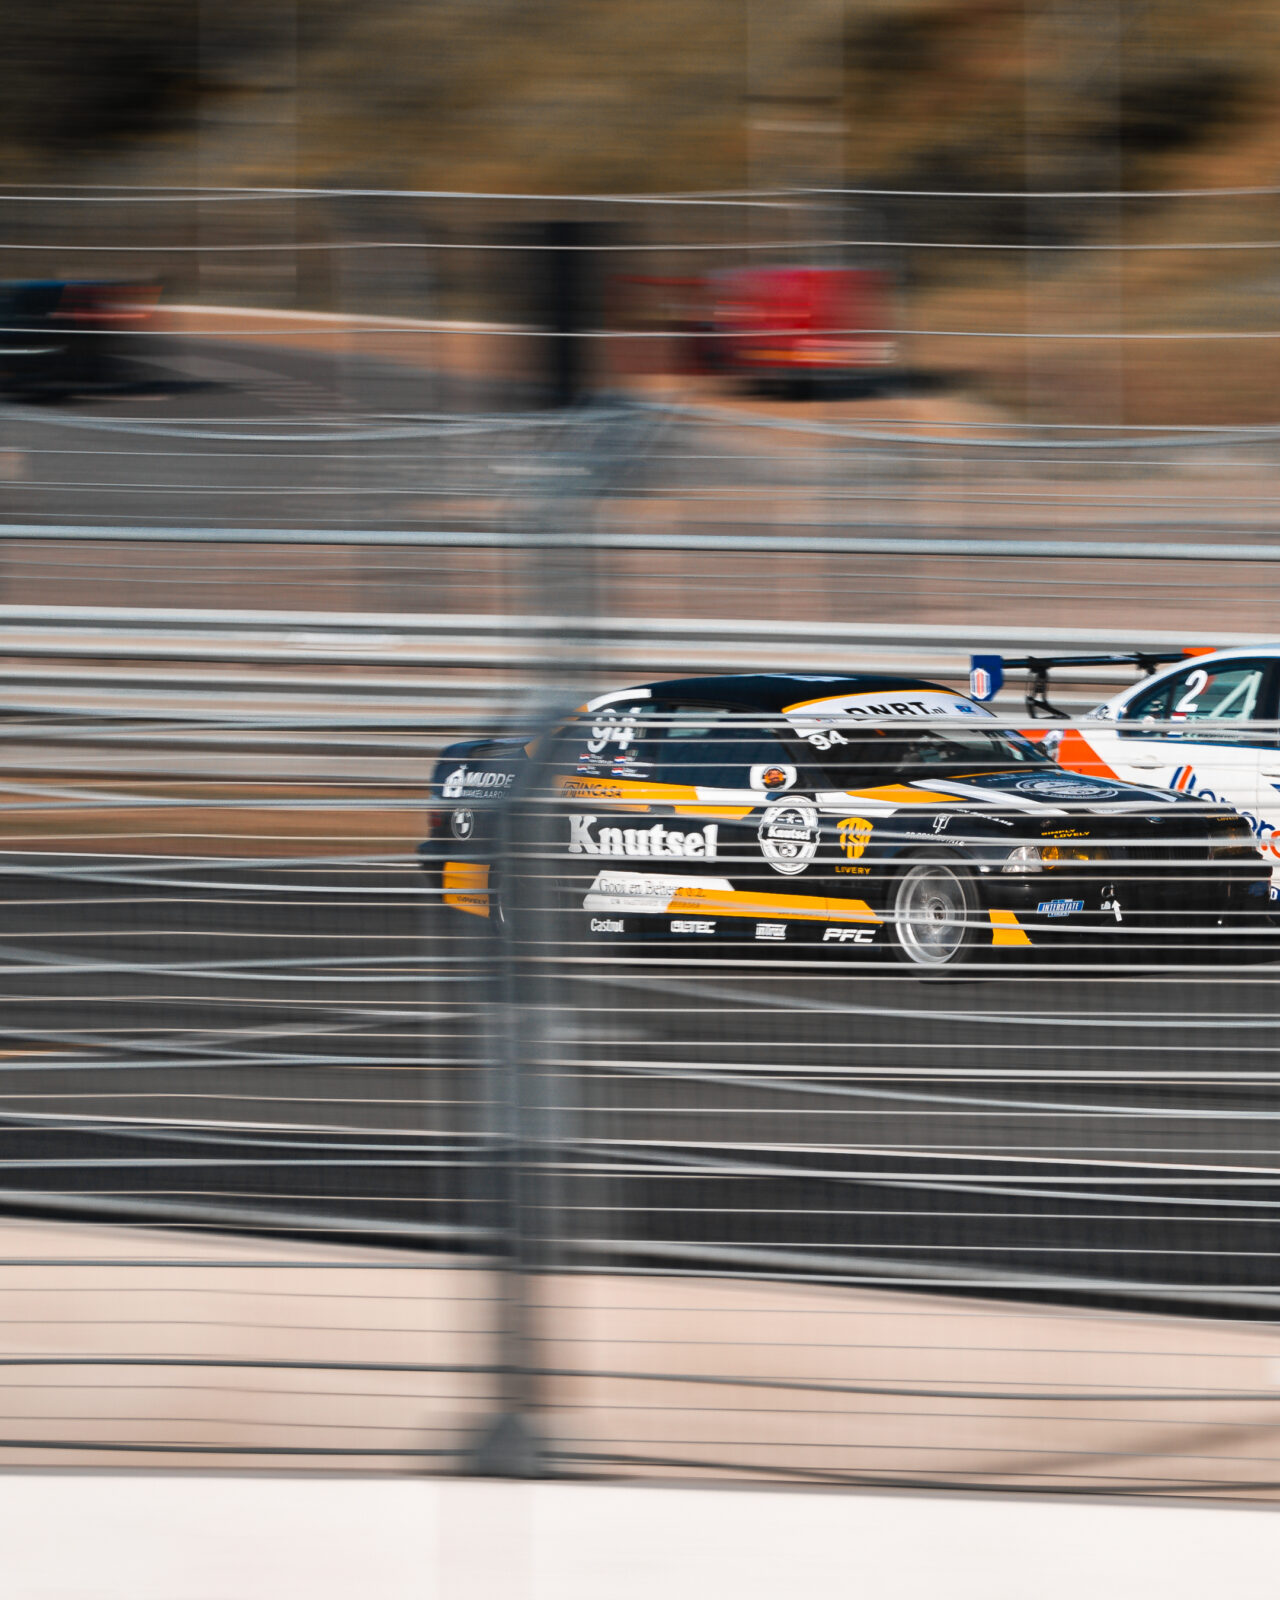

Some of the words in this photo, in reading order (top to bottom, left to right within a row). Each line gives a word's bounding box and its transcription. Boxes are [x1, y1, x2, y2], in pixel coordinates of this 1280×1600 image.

[1174, 669, 1209, 713] 2
[587, 707, 642, 753] 94
[808, 730, 849, 751] 94
[568, 815, 719, 862] Knutsel
[767, 825, 812, 842] Knutsel
[834, 865, 871, 875] LIVERY
[1041, 903, 1080, 913] INTERSTATE
[822, 926, 877, 943] PFC
